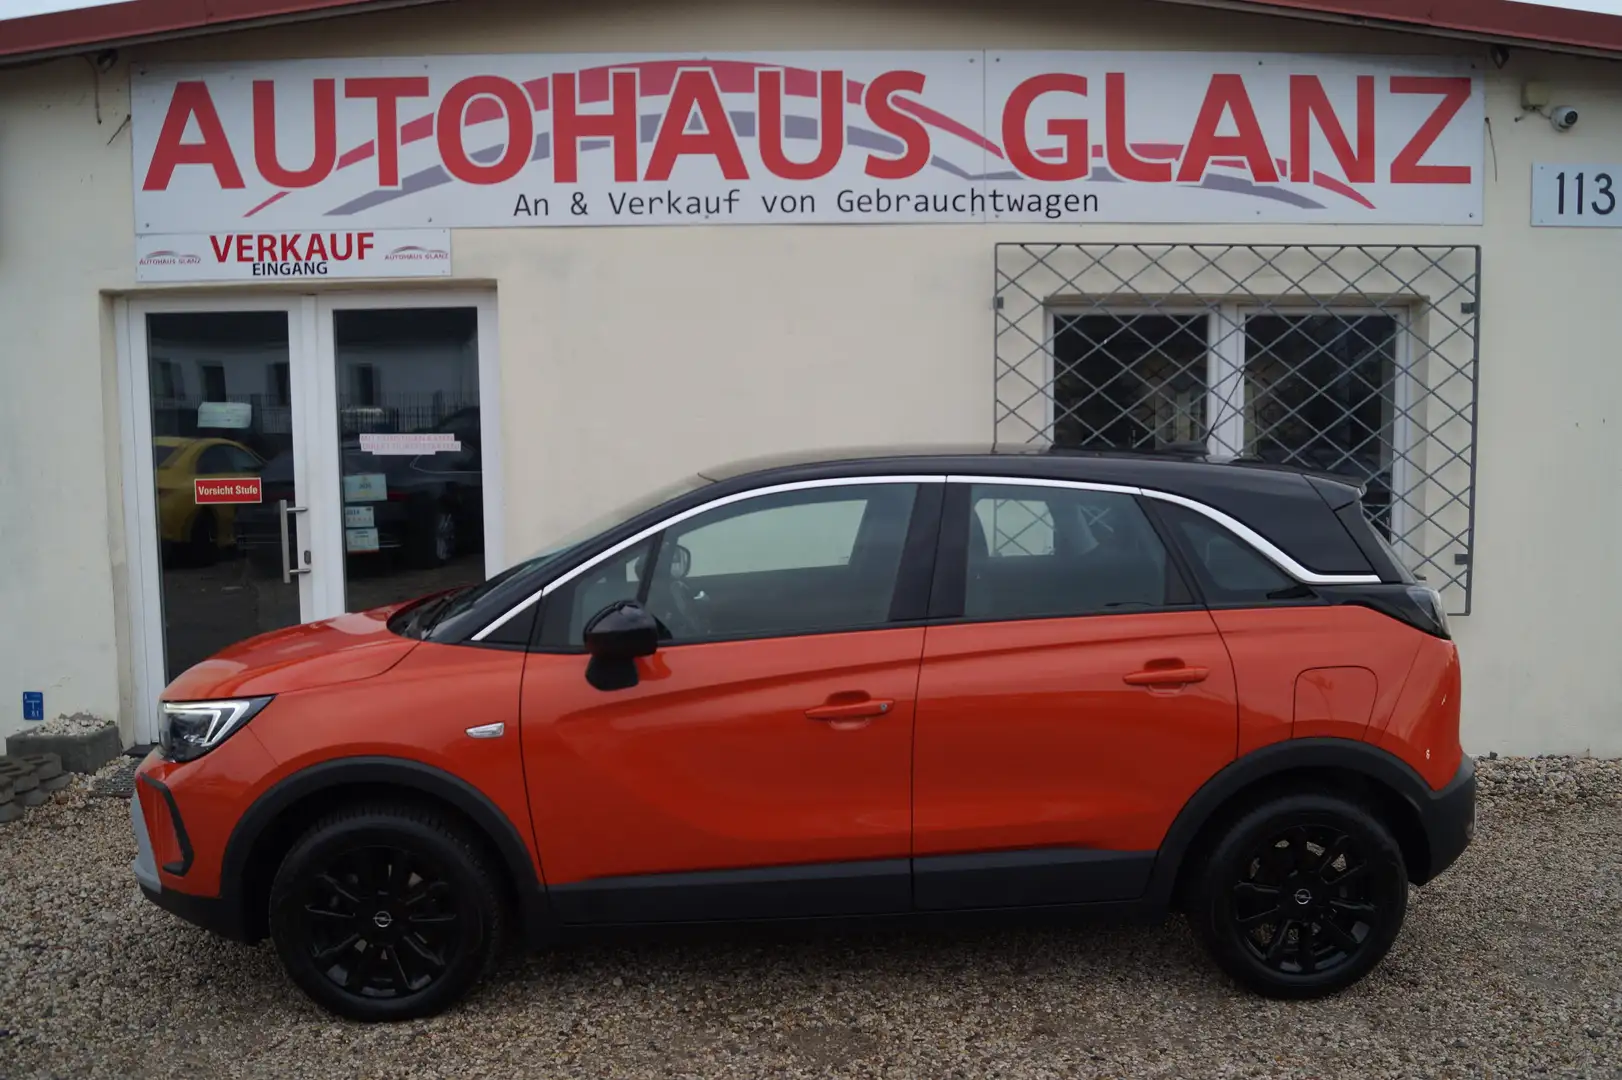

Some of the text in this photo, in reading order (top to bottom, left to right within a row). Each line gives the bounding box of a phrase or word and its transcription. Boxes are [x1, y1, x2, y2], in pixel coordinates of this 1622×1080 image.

[142, 66, 1473, 191] AUTOHAUS GLANZ
[513, 188, 1099, 219] An & Verkauf von Gebrauchtwagen
[1556, 171, 1616, 215] 113
[209, 231, 374, 263] VERKAUF
[385, 252, 449, 261] AUTOHAUS GLANZ
[139, 257, 176, 265] AUTOHAUS
[252, 261, 328, 276] EINGANG
[198, 484, 258, 496] Vorsicht Stufe
